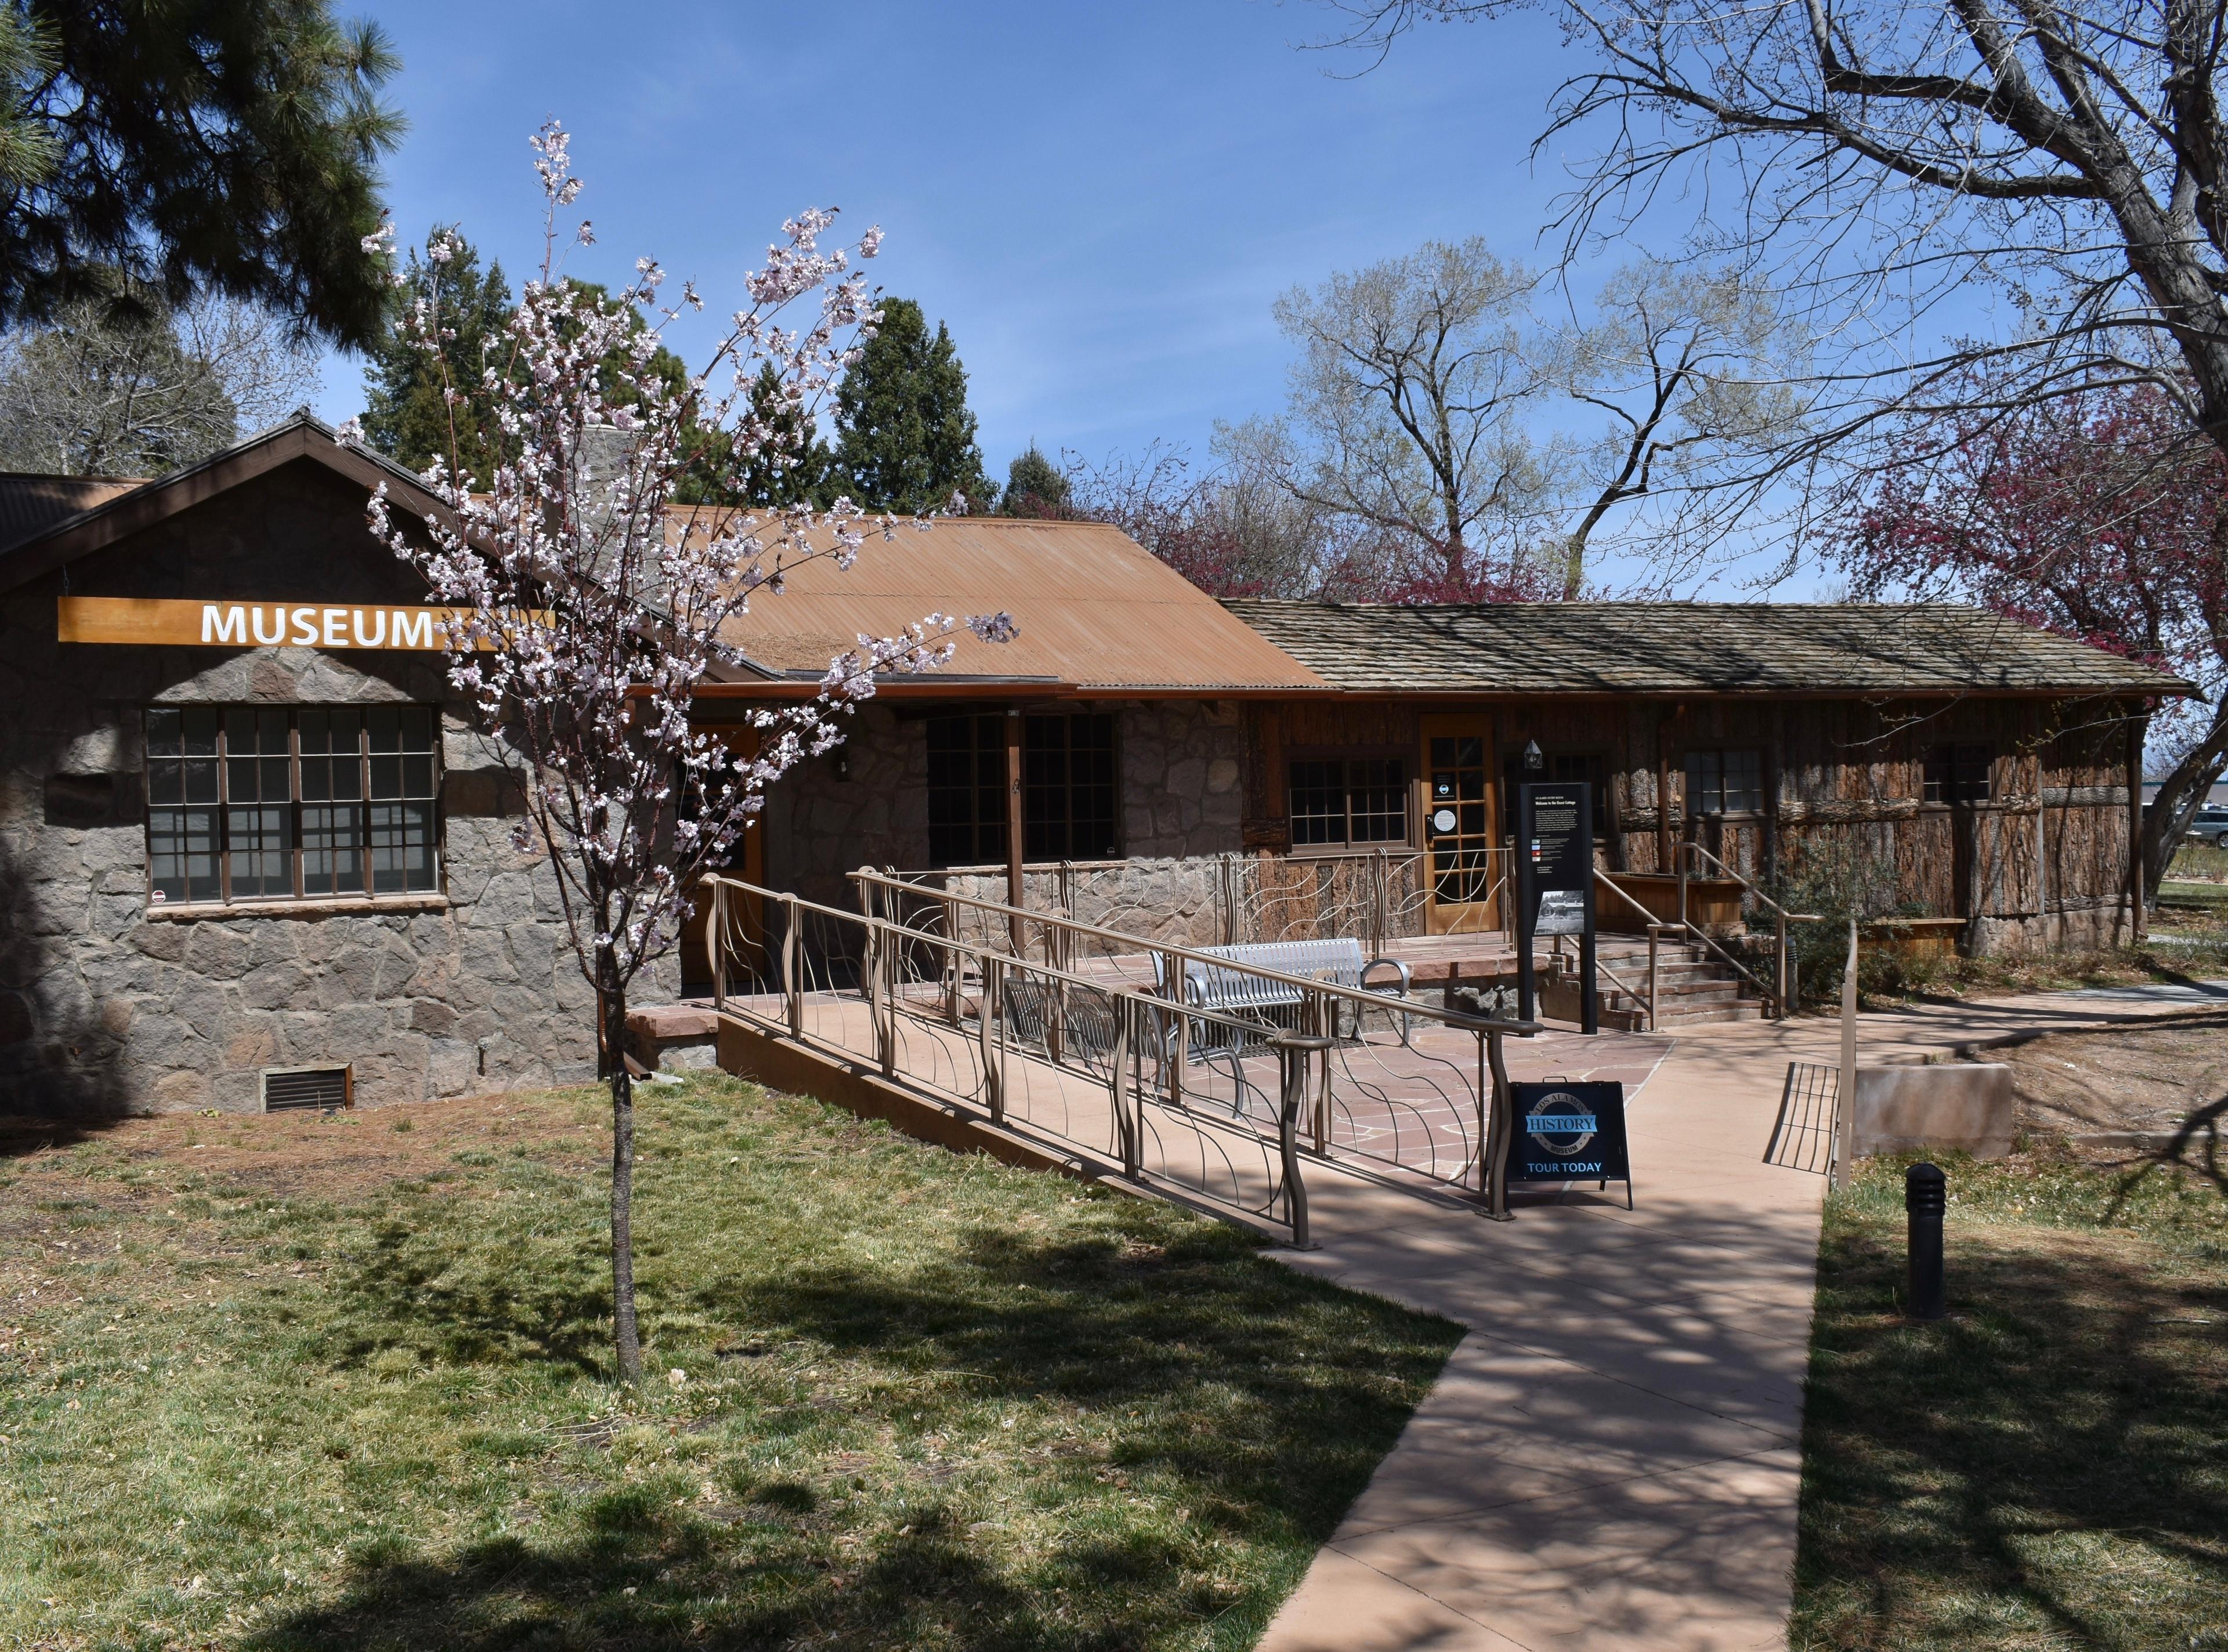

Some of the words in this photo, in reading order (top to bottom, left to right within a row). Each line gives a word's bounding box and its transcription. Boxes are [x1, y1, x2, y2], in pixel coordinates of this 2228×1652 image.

[201, 604, 433, 647] MUSEUM
[1536, 1099, 1550, 1113] LOS
[1551, 1093, 1586, 1113] ALAMOS
[1529, 1118, 1594, 1131] HISTORY
[1550, 1145, 1579, 1154] MUSEUM
[1527, 1163, 1560, 1172] TOUR
[1561, 1162, 1601, 1172] TODAY
